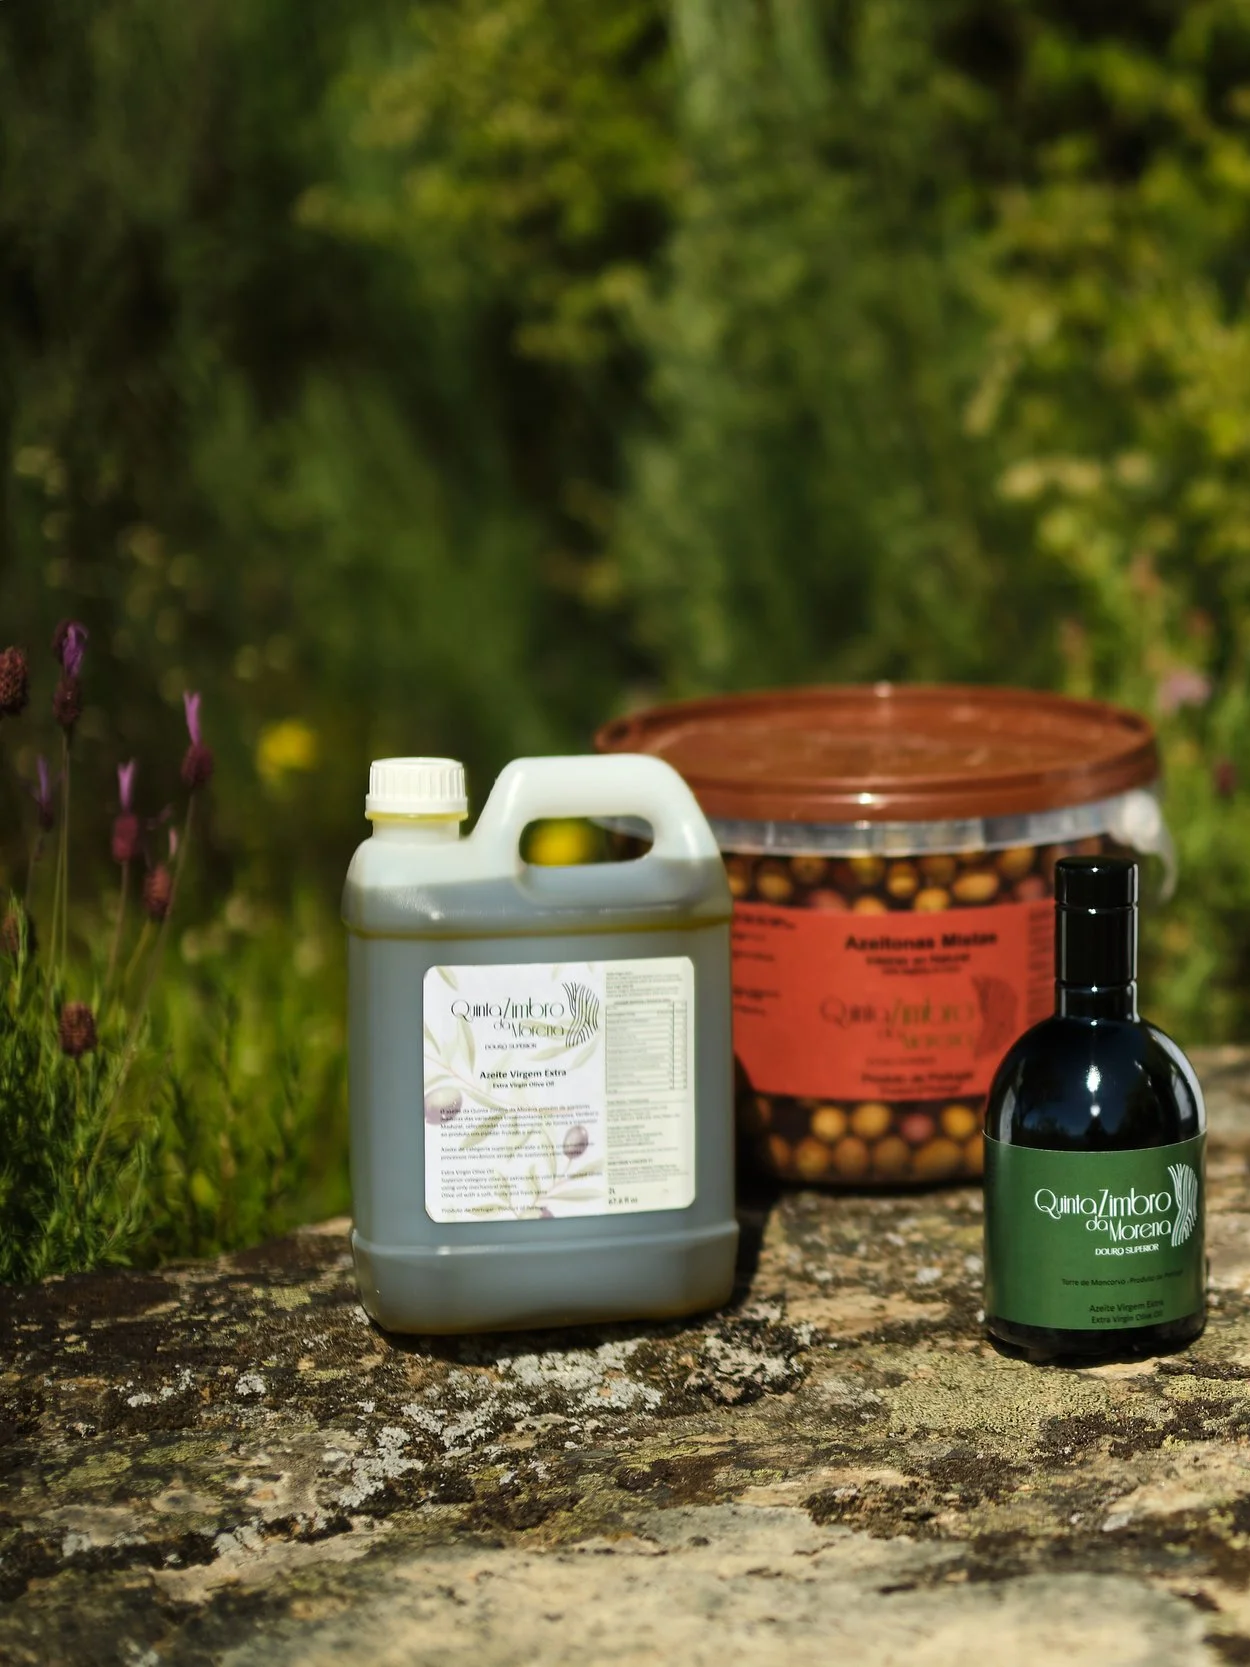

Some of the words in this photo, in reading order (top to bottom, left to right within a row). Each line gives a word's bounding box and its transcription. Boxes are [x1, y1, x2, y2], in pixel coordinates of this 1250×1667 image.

[845, 935, 935, 950] Azeitonas
[451, 999, 502, 1023] Quinta
[493, 1019, 511, 1031] da
[511, 1023, 564, 1038] Morena
[480, 1071, 507, 1079] Azeite
[510, 1070, 542, 1080] Virgem
[545, 1069, 567, 1077] Extra
[1034, 1188, 1097, 1219] Quinta
[1097, 1187, 1172, 1217] Zimbro
[1086, 1216, 1109, 1232] da
[1109, 1219, 1171, 1242] Morena
[1095, 1247, 1124, 1256] DOURO
[1125, 1243, 1159, 1254] SUPERIOR
[1061, 1278, 1079, 1286] Torre
[1089, 1304, 1115, 1312] Azeite
[1116, 1303, 1145, 1312] Virgem
[1091, 1316, 1111, 1324] Extra
[1112, 1315, 1134, 1323] Virgin
